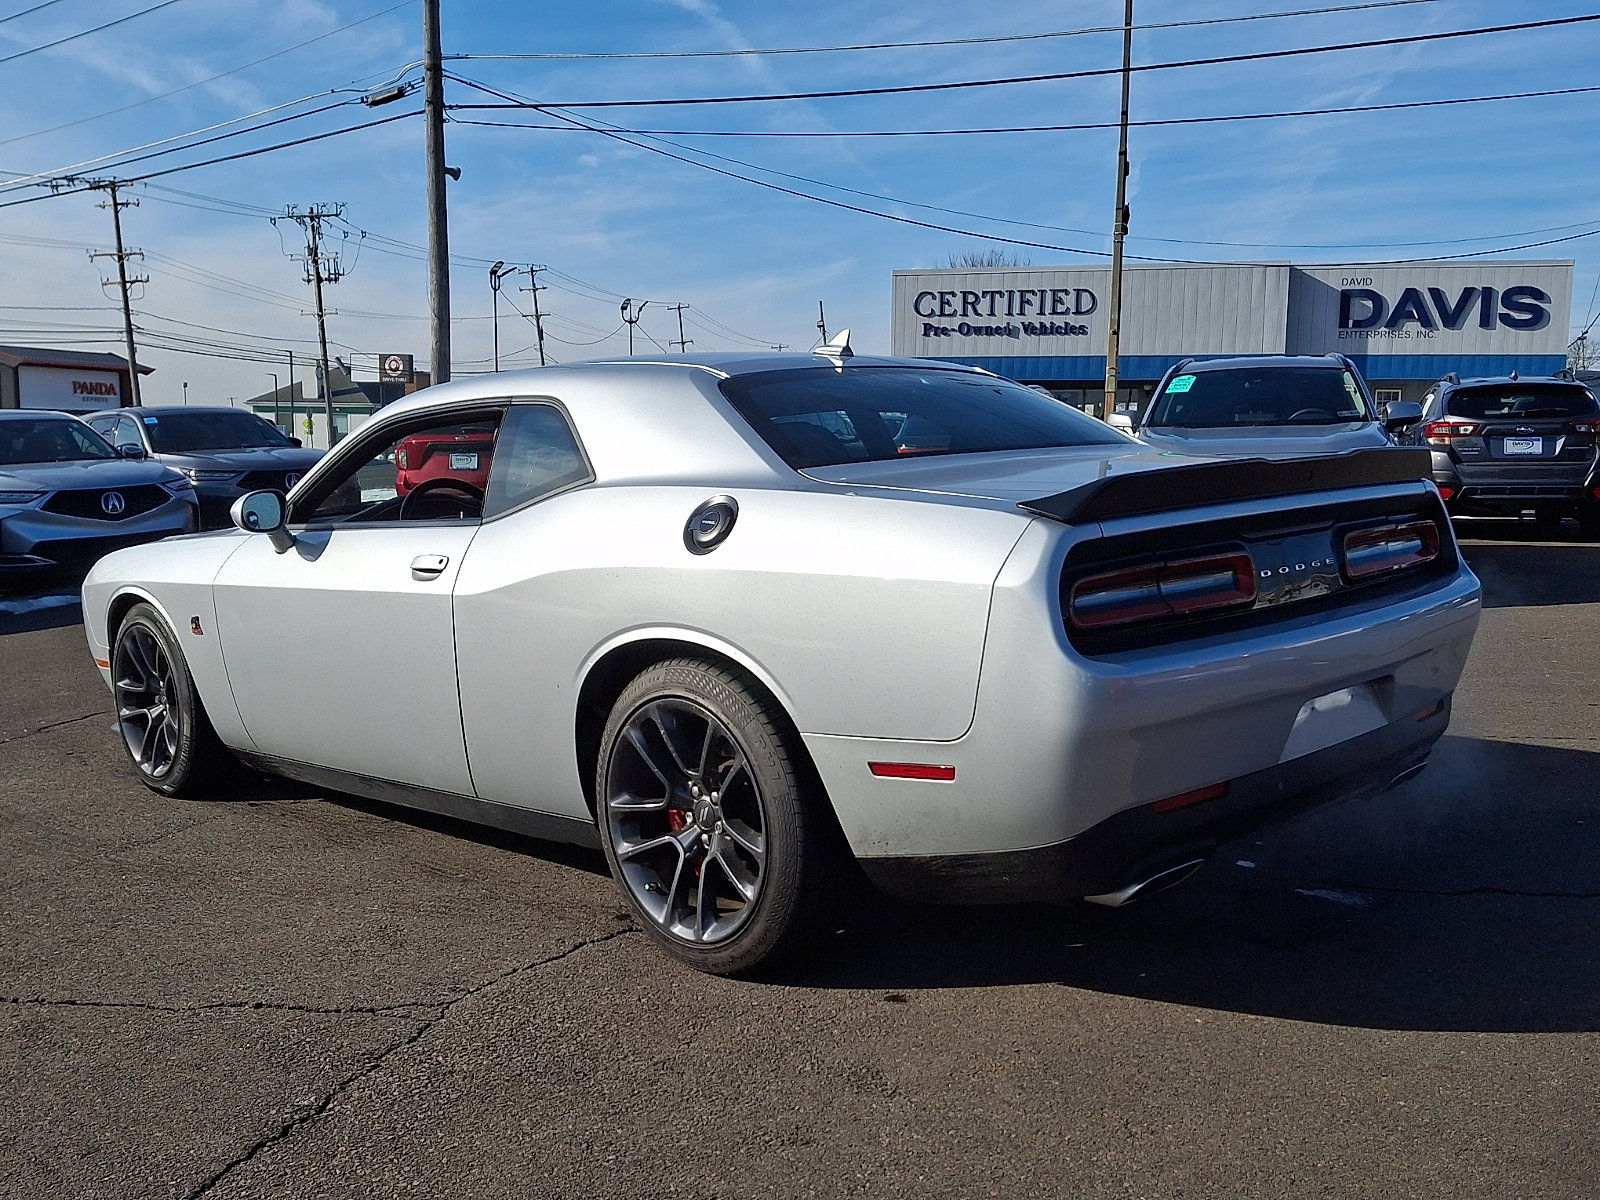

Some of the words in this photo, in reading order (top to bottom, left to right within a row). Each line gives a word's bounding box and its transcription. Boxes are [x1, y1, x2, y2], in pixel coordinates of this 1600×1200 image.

[1341, 277, 1373, 287] DAVID
[913, 288, 1099, 318] CERTIFIED
[1338, 286, 1552, 332] DAVIS
[922, 321, 1014, 338] Pre-Owned
[1021, 321, 1089, 337] Vehicles
[1338, 329, 1414, 340] ENTERPRISES,
[1416, 329, 1437, 339] INC.
[72, 380, 117, 396] PANDA
[1259, 557, 1335, 578] DODGE
